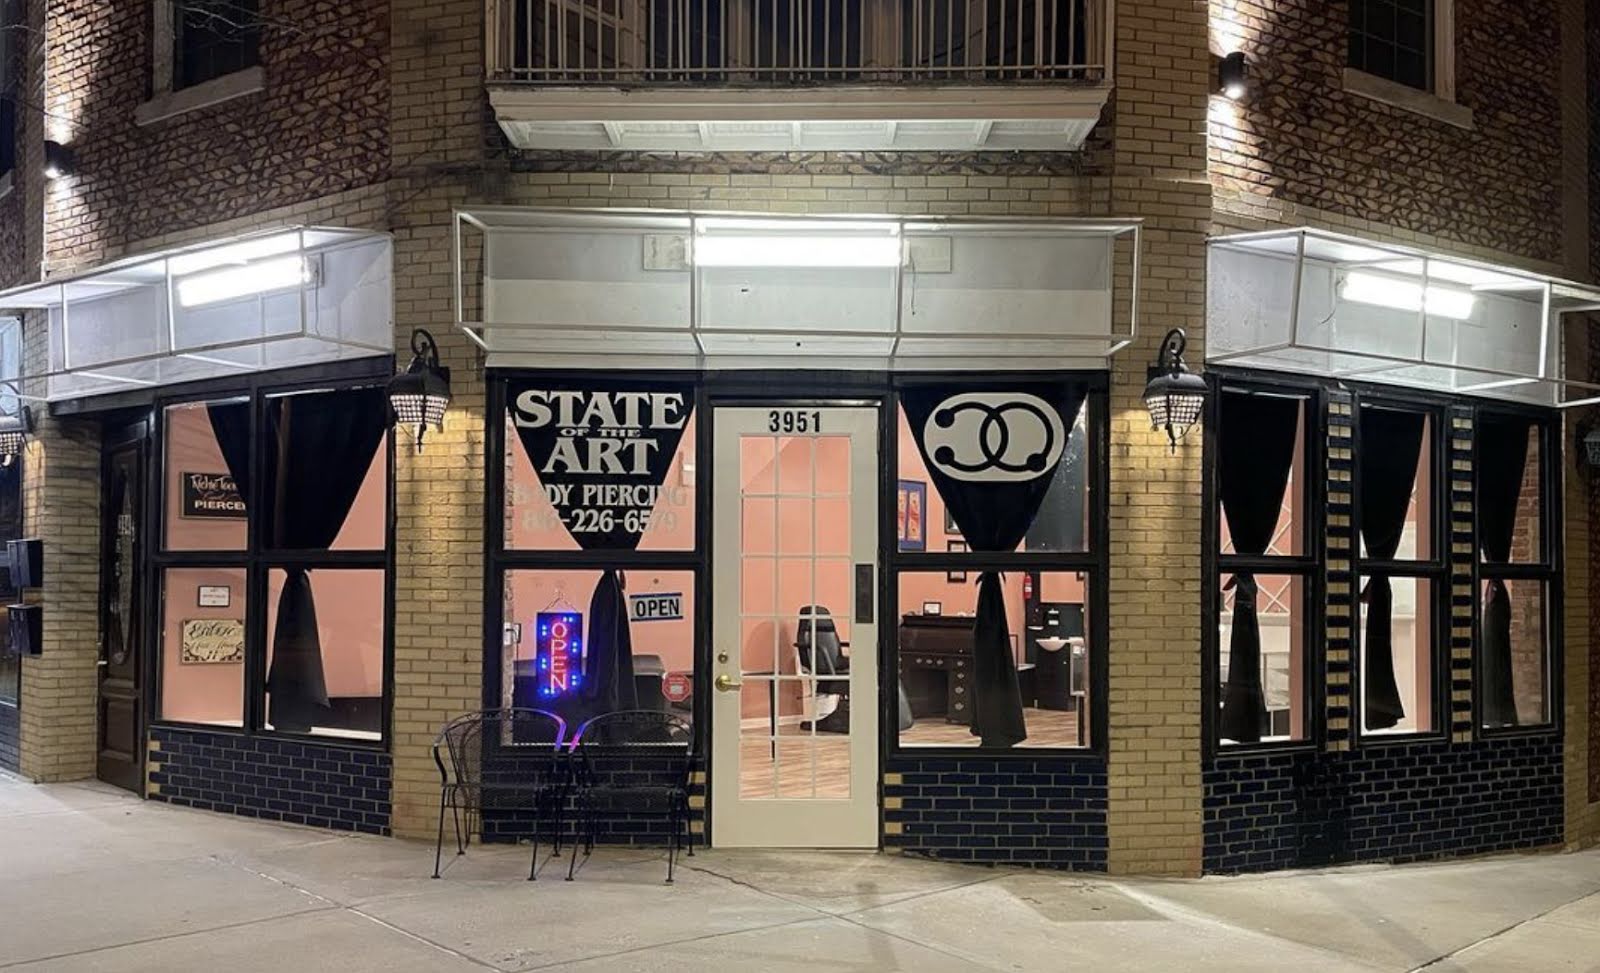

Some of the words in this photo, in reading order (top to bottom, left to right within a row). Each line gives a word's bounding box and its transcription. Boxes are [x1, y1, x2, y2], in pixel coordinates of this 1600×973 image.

[515, 390, 687, 429] STATE
[769, 411, 821, 432] 3951
[560, 428, 590, 437] OF
[597, 428, 641, 437] THE
[541, 437, 659, 474] ART
[635, 599, 680, 617] OPEN
[550, 622, 567, 694] OPEN
